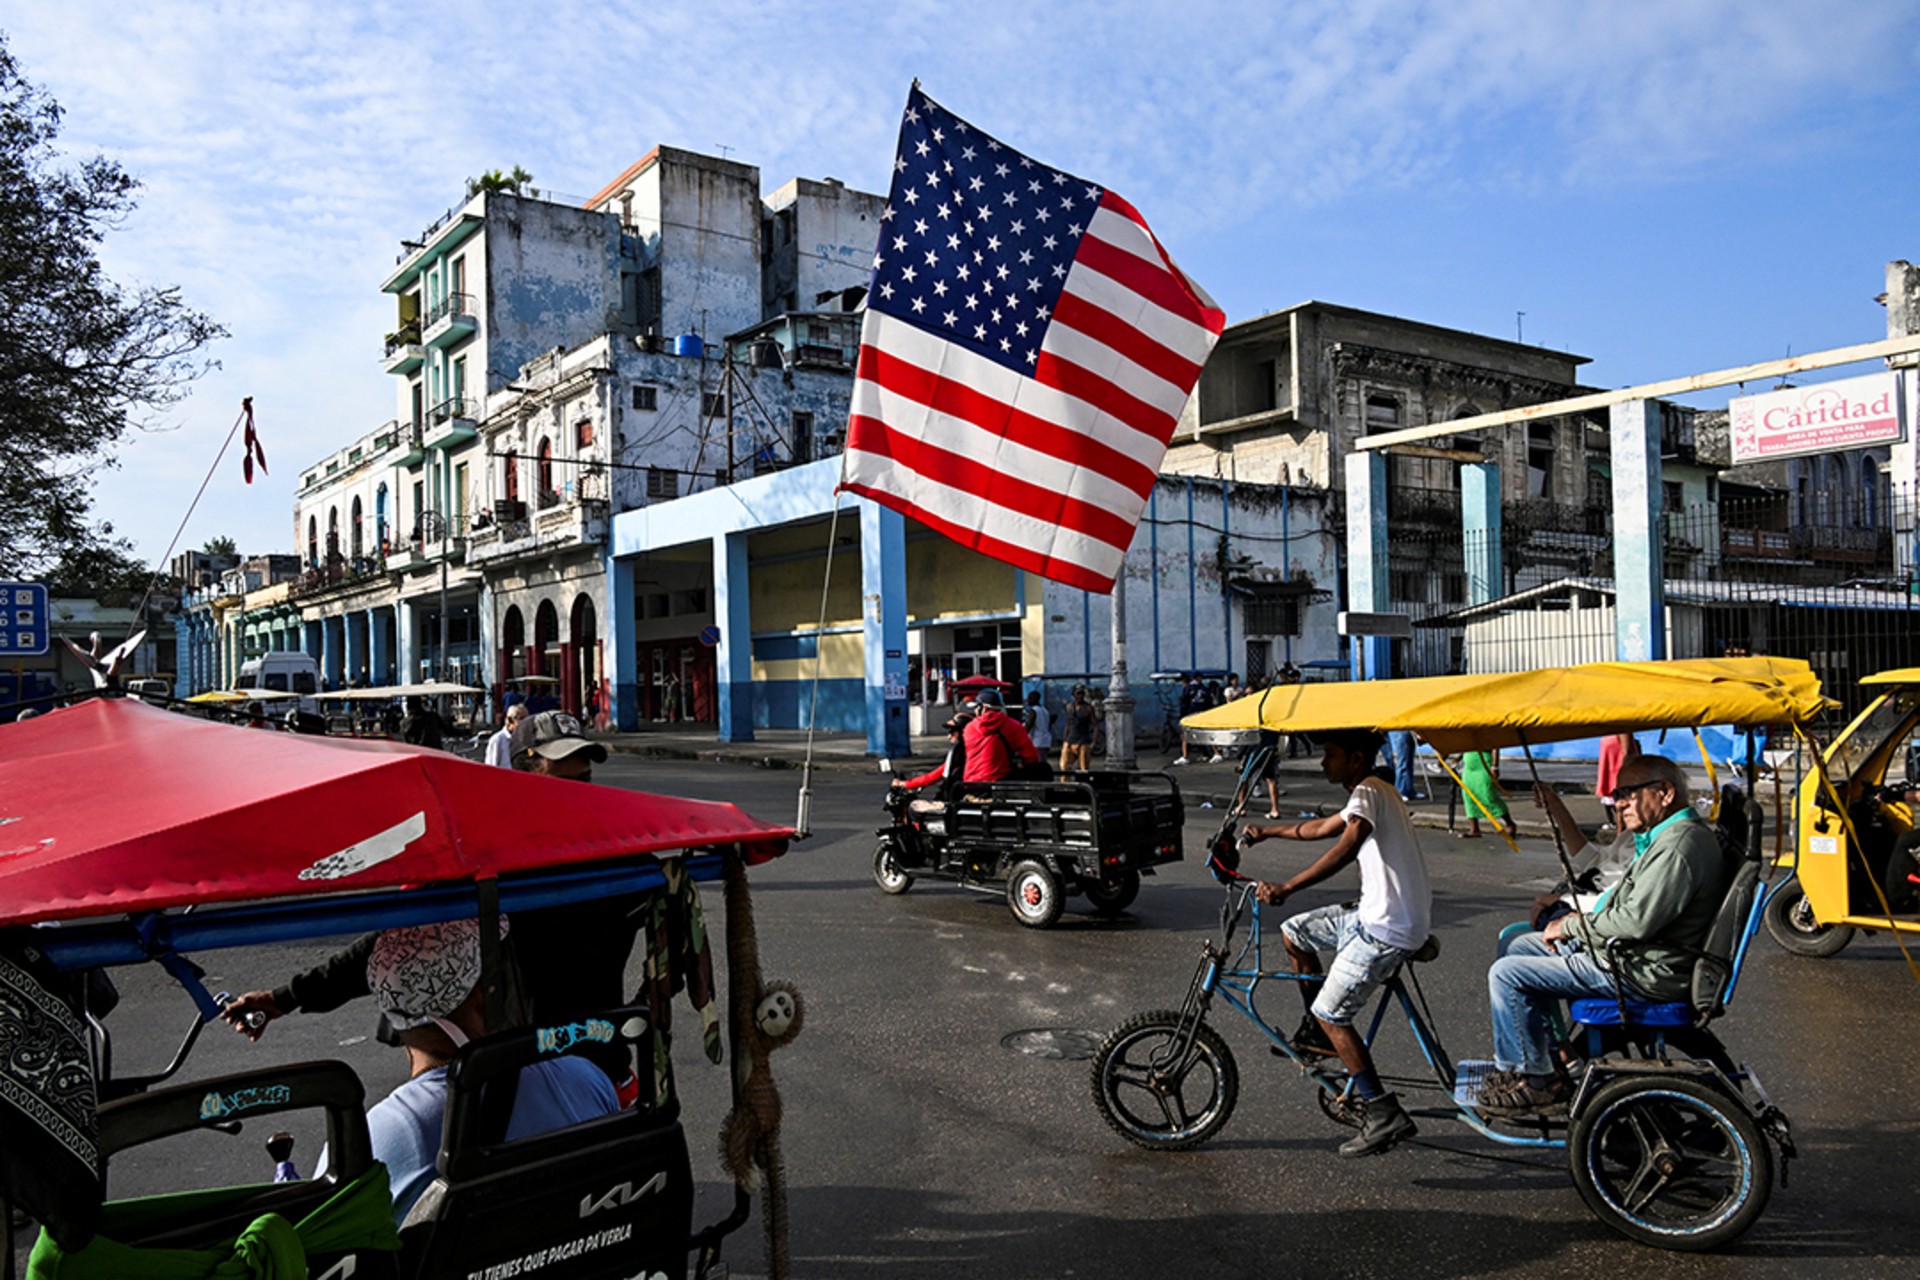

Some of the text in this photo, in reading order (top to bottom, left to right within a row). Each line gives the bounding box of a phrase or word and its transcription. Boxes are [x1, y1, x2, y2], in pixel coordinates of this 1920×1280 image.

[1763, 392, 1890, 431] Caridad
[1818, 436, 1833, 444] POR
[1835, 433, 1865, 442] CUENTA
[1866, 428, 1894, 437] PROPIA
[1820, 428, 1843, 436] VENTA
[1845, 424, 1865, 432] PARA
[485, 1257, 523, 1280] TIENES
[523, 1249, 548, 1272] QUE
[547, 1238, 585, 1265] PAGAR
